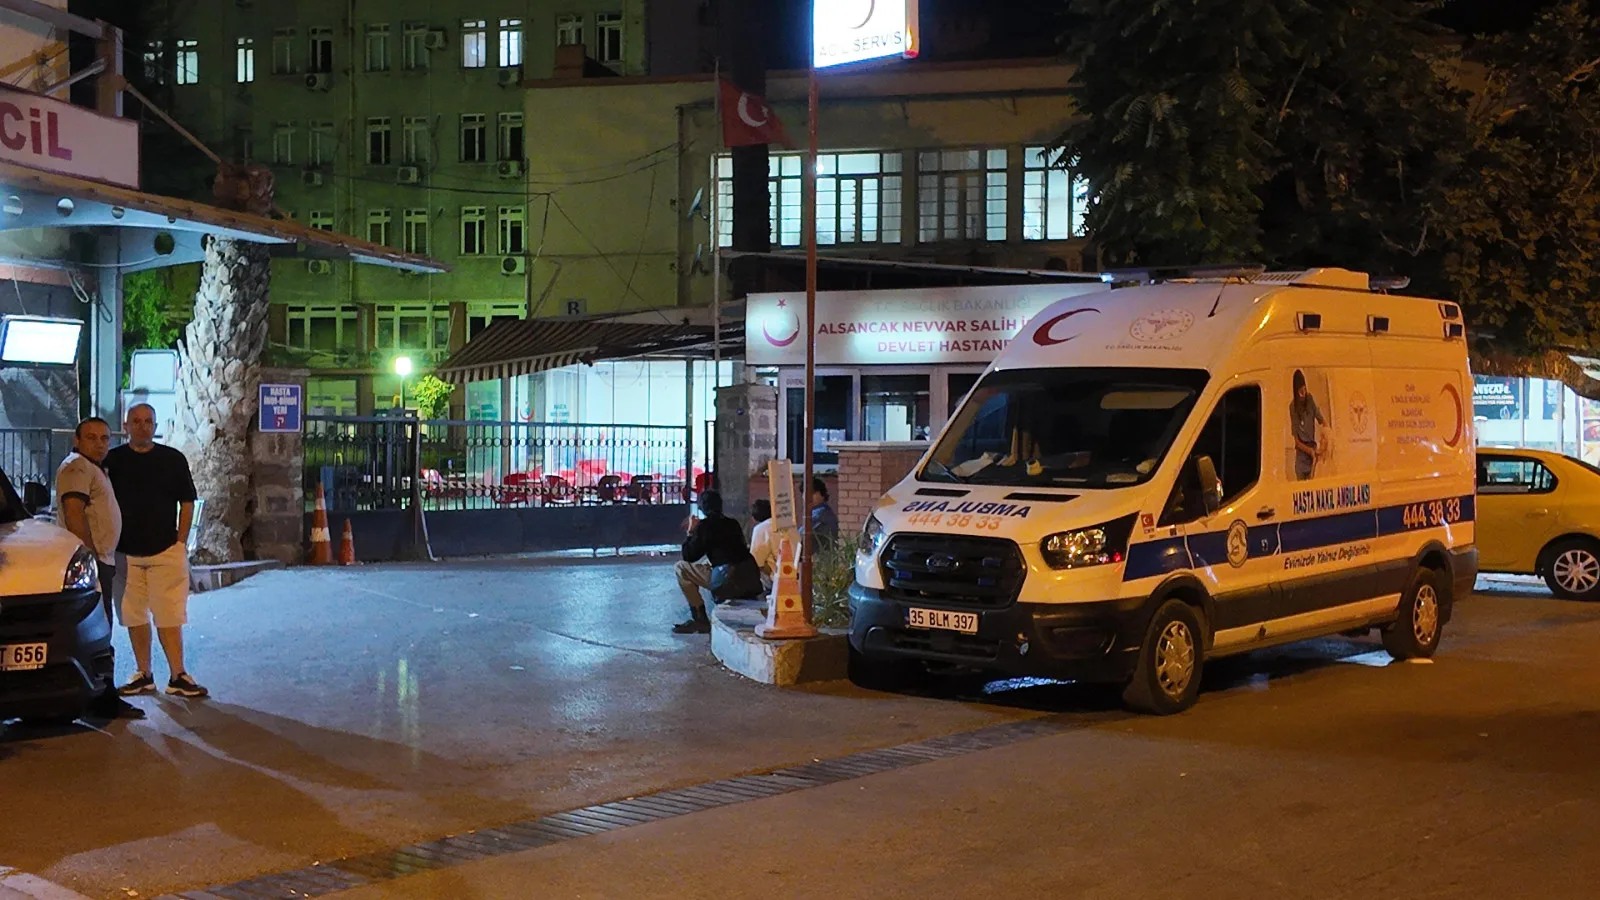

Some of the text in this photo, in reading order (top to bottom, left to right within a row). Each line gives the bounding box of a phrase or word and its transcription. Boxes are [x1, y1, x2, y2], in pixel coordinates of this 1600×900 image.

[568, 302, 579, 315] R
[818, 322, 899, 334] ALSANCAK
[903, 320, 966, 332] NEVVAR
[970, 317, 1016, 332] SALİH
[878, 341, 936, 352] DEVLET
[1292, 491, 1315, 515] HASTA
[907, 512, 1003, 530] 444 38 33
[1403, 498, 1460, 528] 444 38 33
[910, 610, 974, 630] 35 BLM 397
[14, 646, 44, 663] 656
